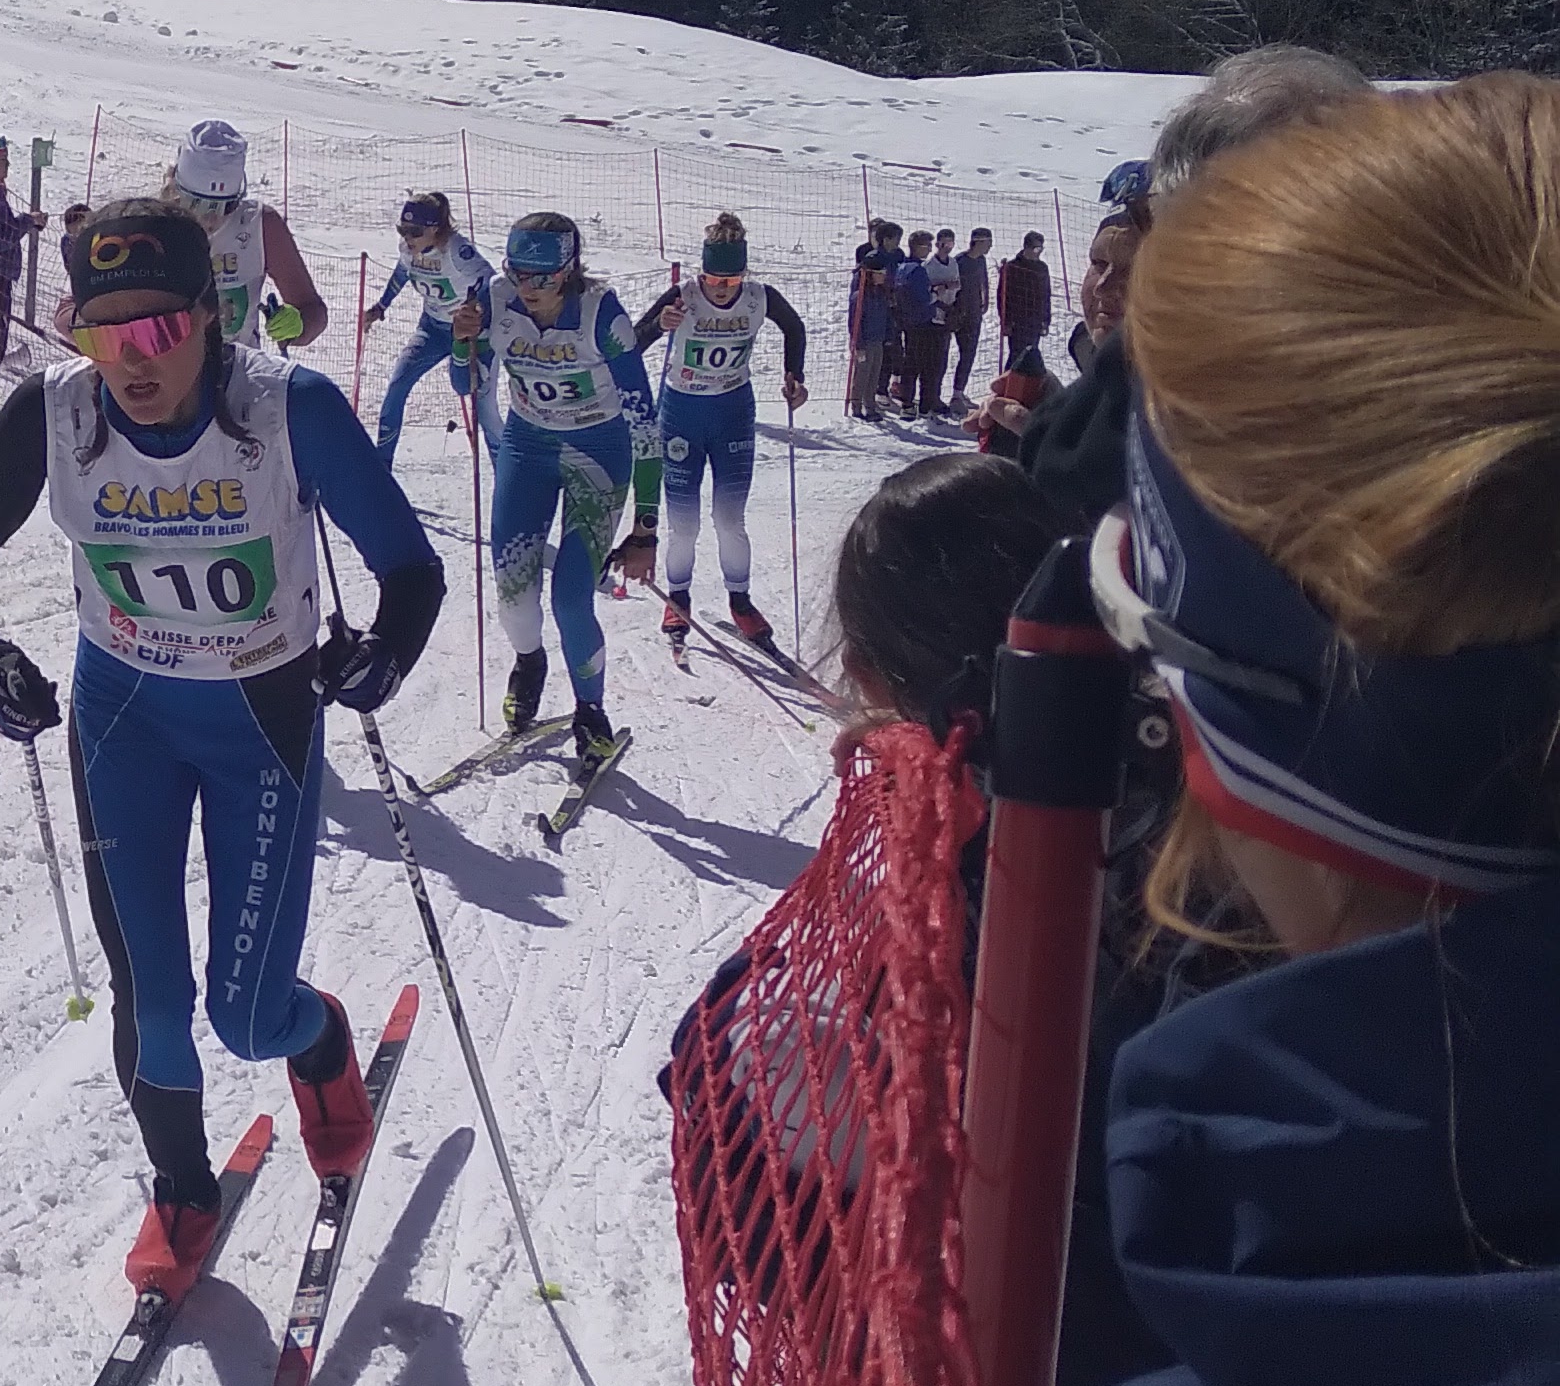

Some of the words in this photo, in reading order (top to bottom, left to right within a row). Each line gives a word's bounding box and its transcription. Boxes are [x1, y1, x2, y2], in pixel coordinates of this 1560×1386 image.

[691, 344, 748, 369] 107
[93, 478, 248, 523] SAMSE
[133, 526, 150, 537] LES
[152, 524, 200, 537] HOMMES
[201, 525, 216, 536] EN
[217, 522, 250, 536] BLEU!
[103, 557, 256, 613] 110
[224, 768, 280, 1004] MONTBENOIT
